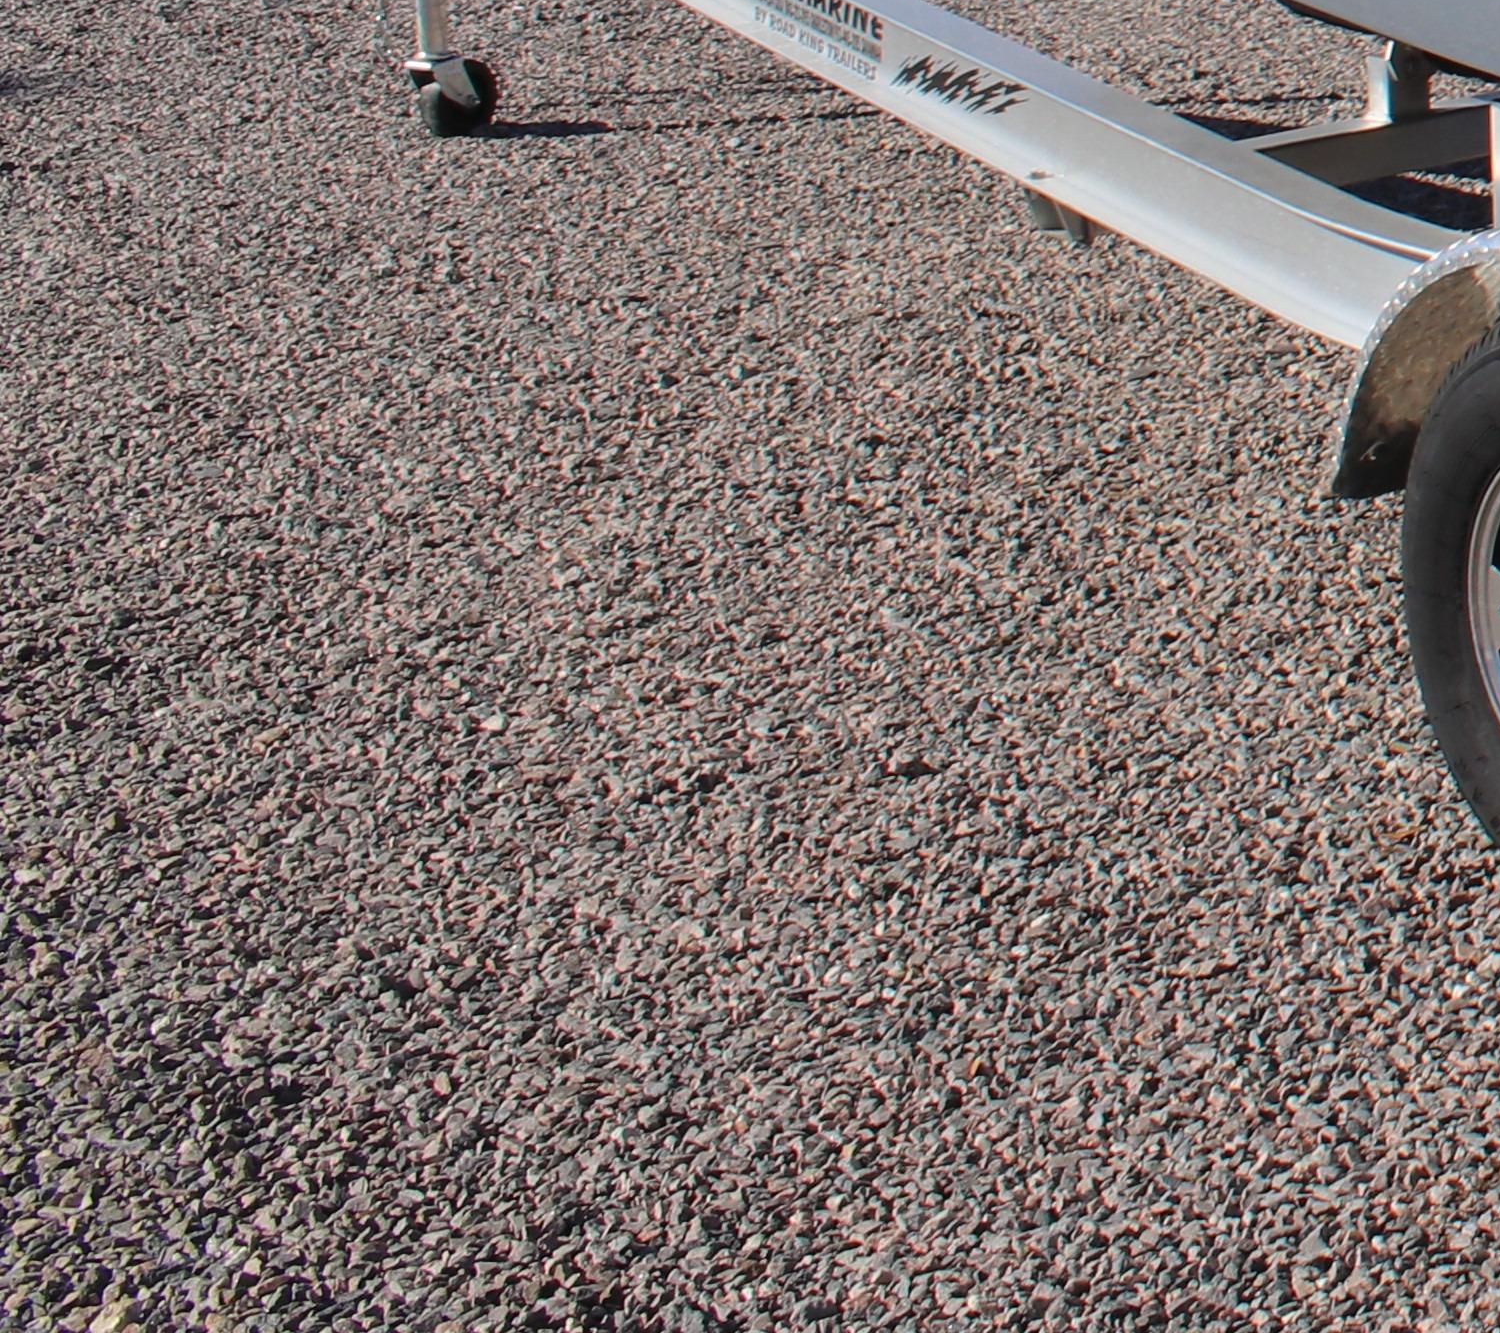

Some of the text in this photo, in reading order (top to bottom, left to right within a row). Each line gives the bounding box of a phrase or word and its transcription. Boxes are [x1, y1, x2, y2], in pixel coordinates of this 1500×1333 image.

[769, 13, 796, 42] ROAD
[798, 27, 825, 55] KING
[826, 42, 878, 81] TRAILERS
